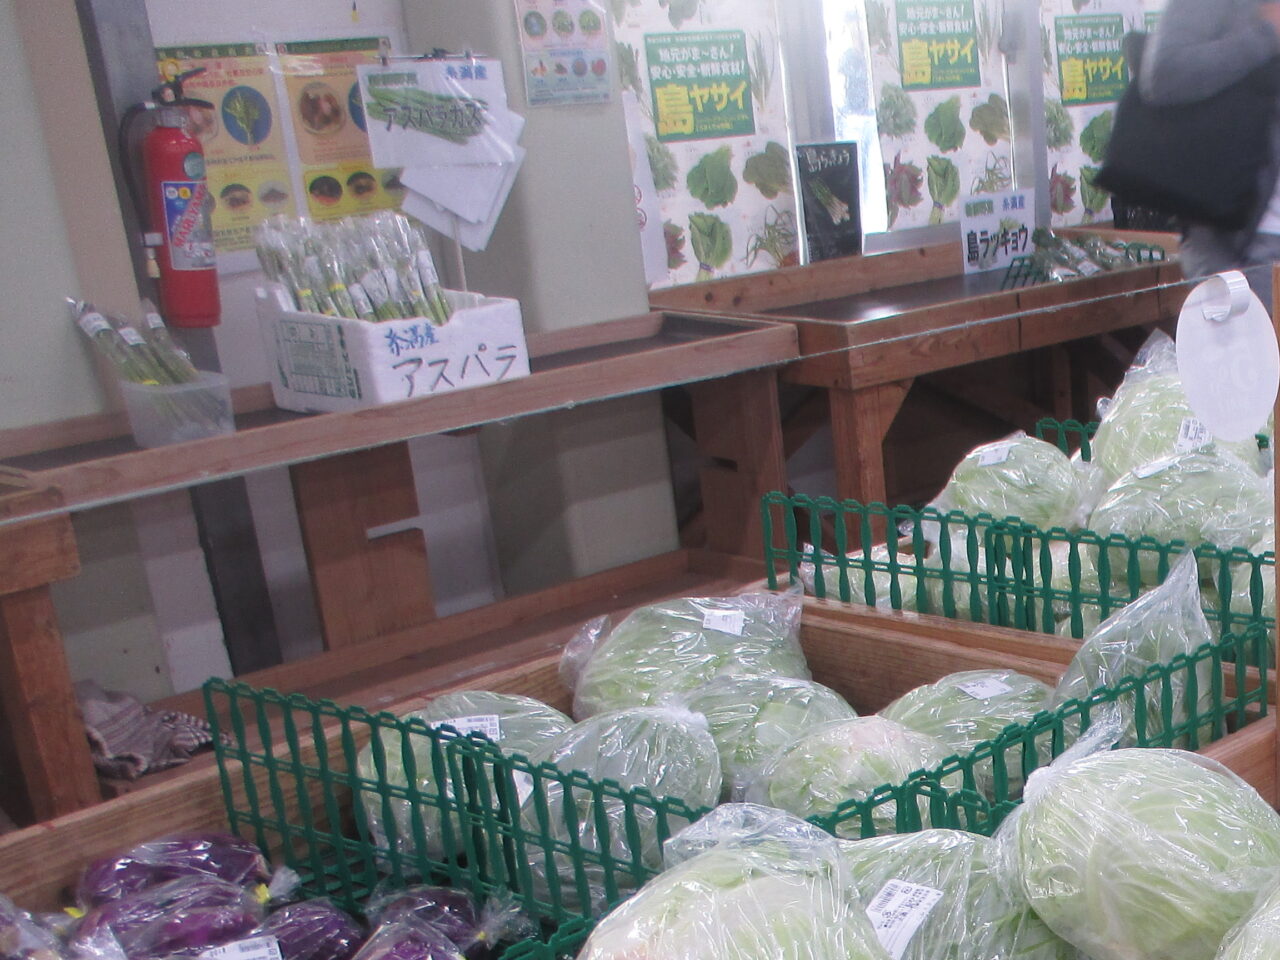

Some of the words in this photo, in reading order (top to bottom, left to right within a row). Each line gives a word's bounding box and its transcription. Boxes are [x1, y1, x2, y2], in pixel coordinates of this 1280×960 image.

[902, 38, 974, 85] 島ヤサイ
[1061, 56, 1125, 101] 島ヤサイ
[656, 81, 747, 136] 島ヤサイ
[392, 343, 517, 397] アスパラ
